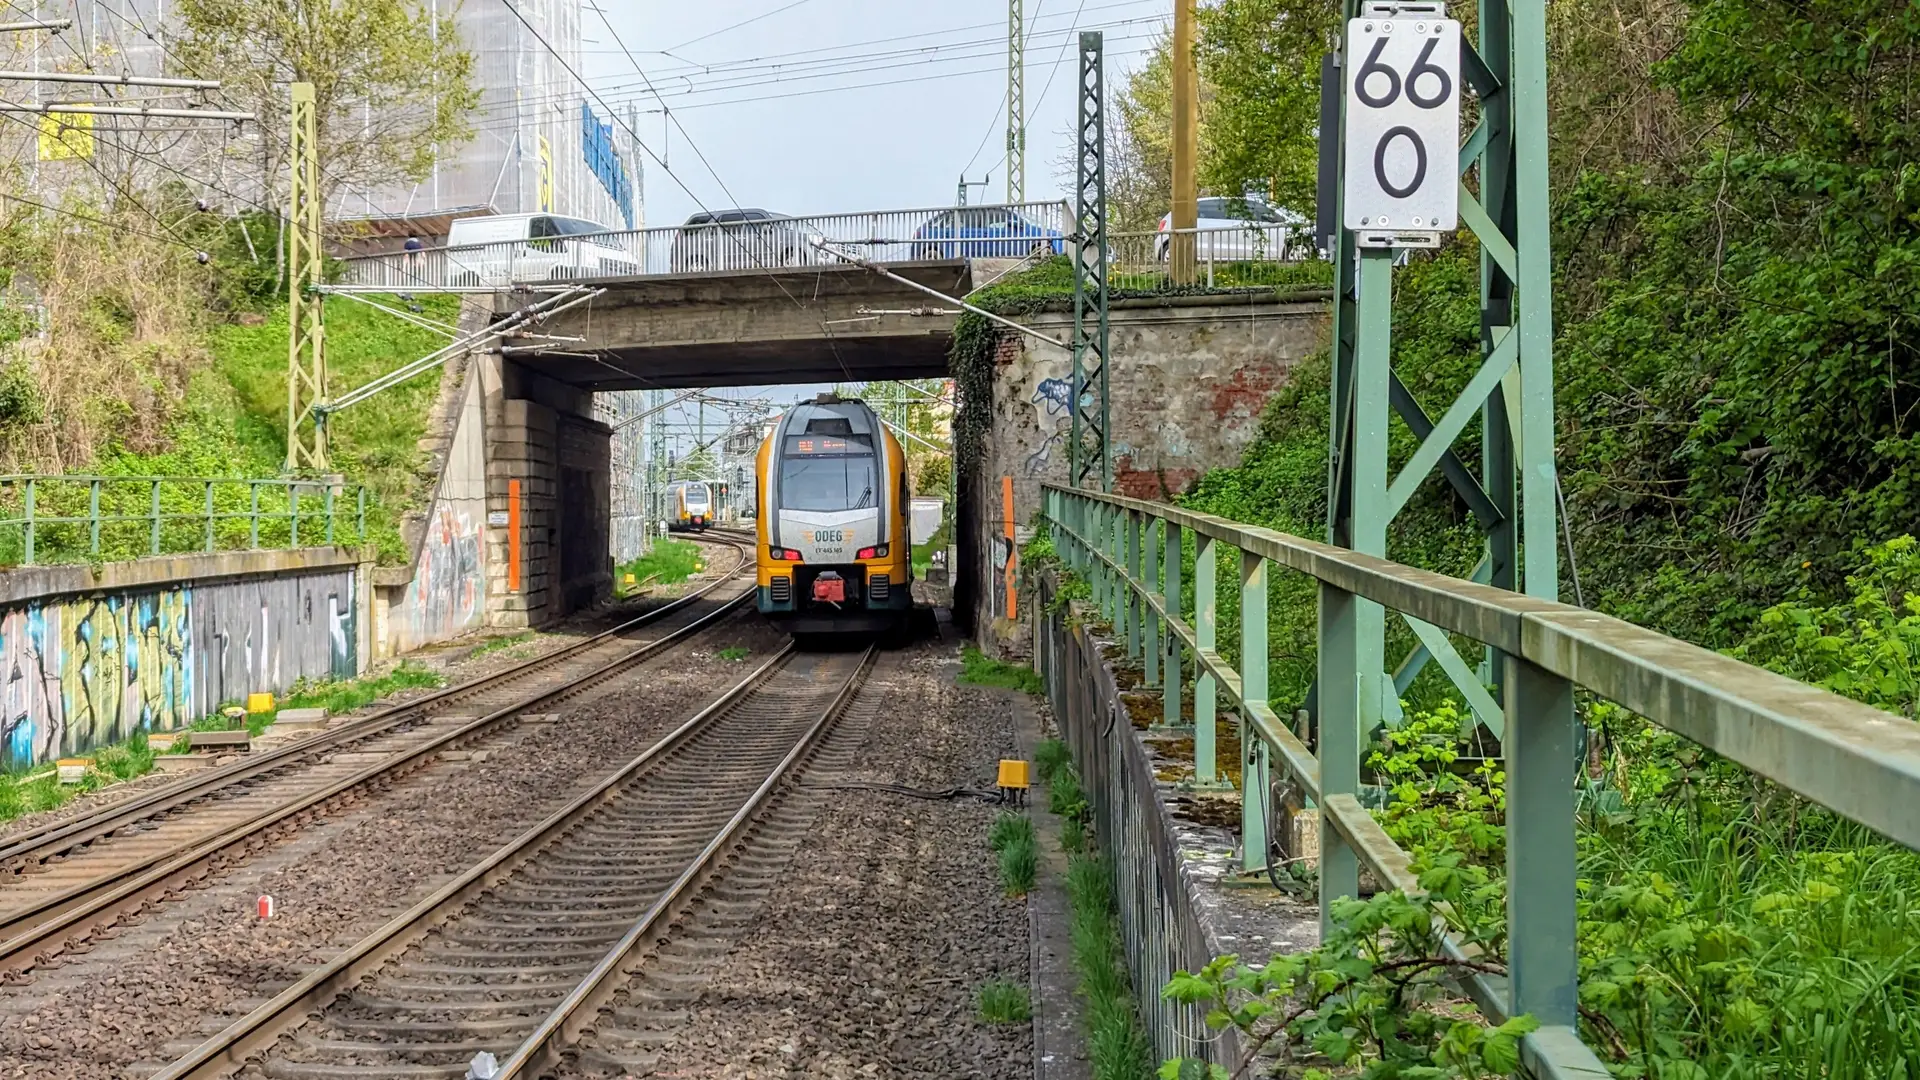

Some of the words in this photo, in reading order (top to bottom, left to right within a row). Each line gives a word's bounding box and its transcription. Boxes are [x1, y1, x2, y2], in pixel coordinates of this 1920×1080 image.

[1354, 36, 1452, 110] 66
[1374, 125, 1428, 199] 0
[815, 530, 843, 542] ODEG
